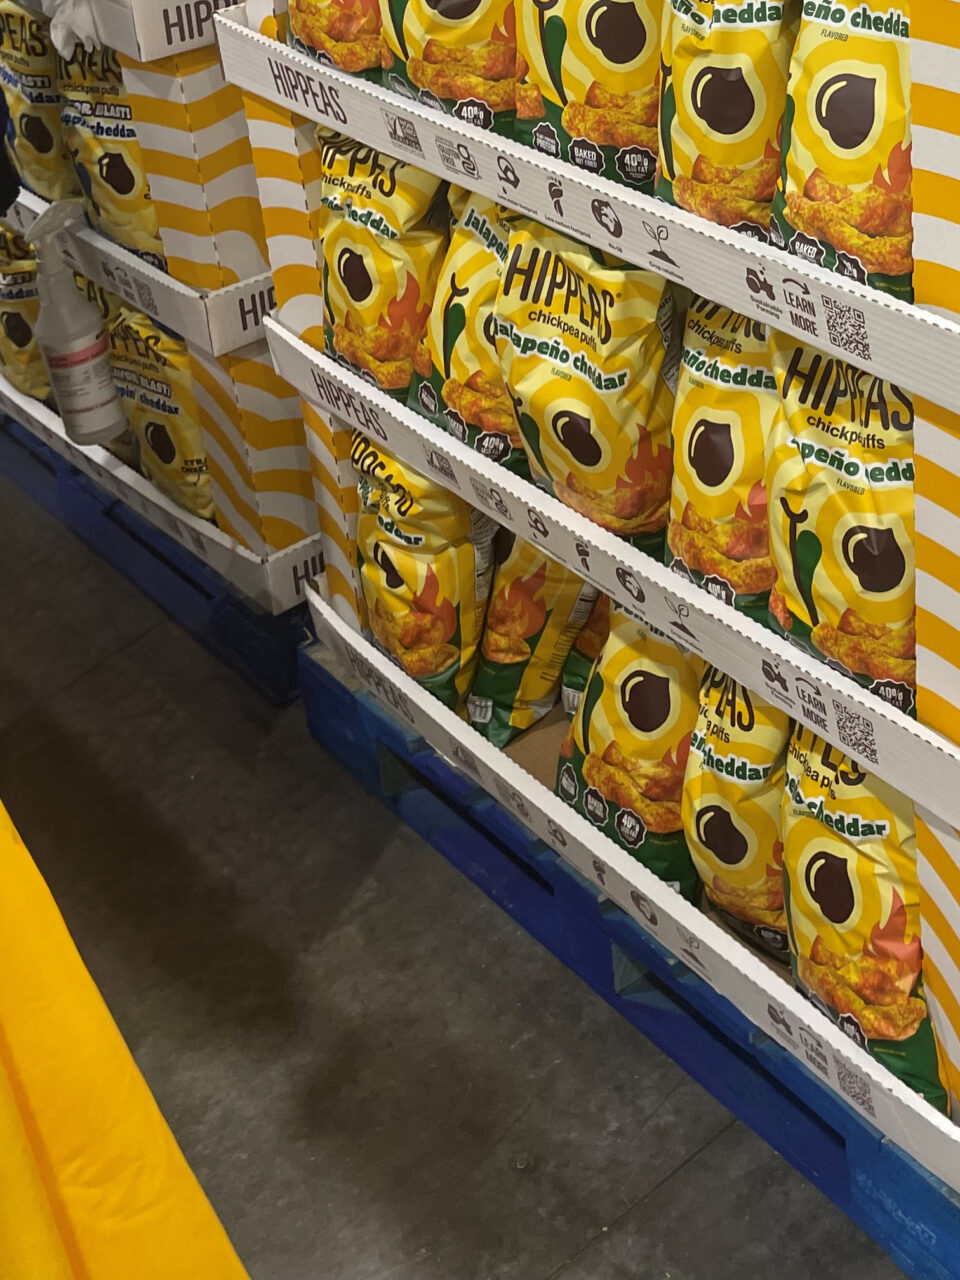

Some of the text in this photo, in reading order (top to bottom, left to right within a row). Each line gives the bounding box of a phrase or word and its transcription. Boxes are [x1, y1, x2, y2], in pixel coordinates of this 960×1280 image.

[267, 56, 348, 125] HIPPEAS
[573, 146, 597, 162] BAKED
[623, 151, 650, 167] 40%
[502, 243, 615, 346] HIPPEAS
[782, 289, 816, 318] LEARN
[528, 308, 581, 342] chickpea
[790, 312, 820, 338] MORE
[493, 320, 570, 365] jalapeño
[311, 369, 389, 443] HIPPEAS
[795, 689, 827, 717] LEARN
[800, 709, 829, 735] MORE
